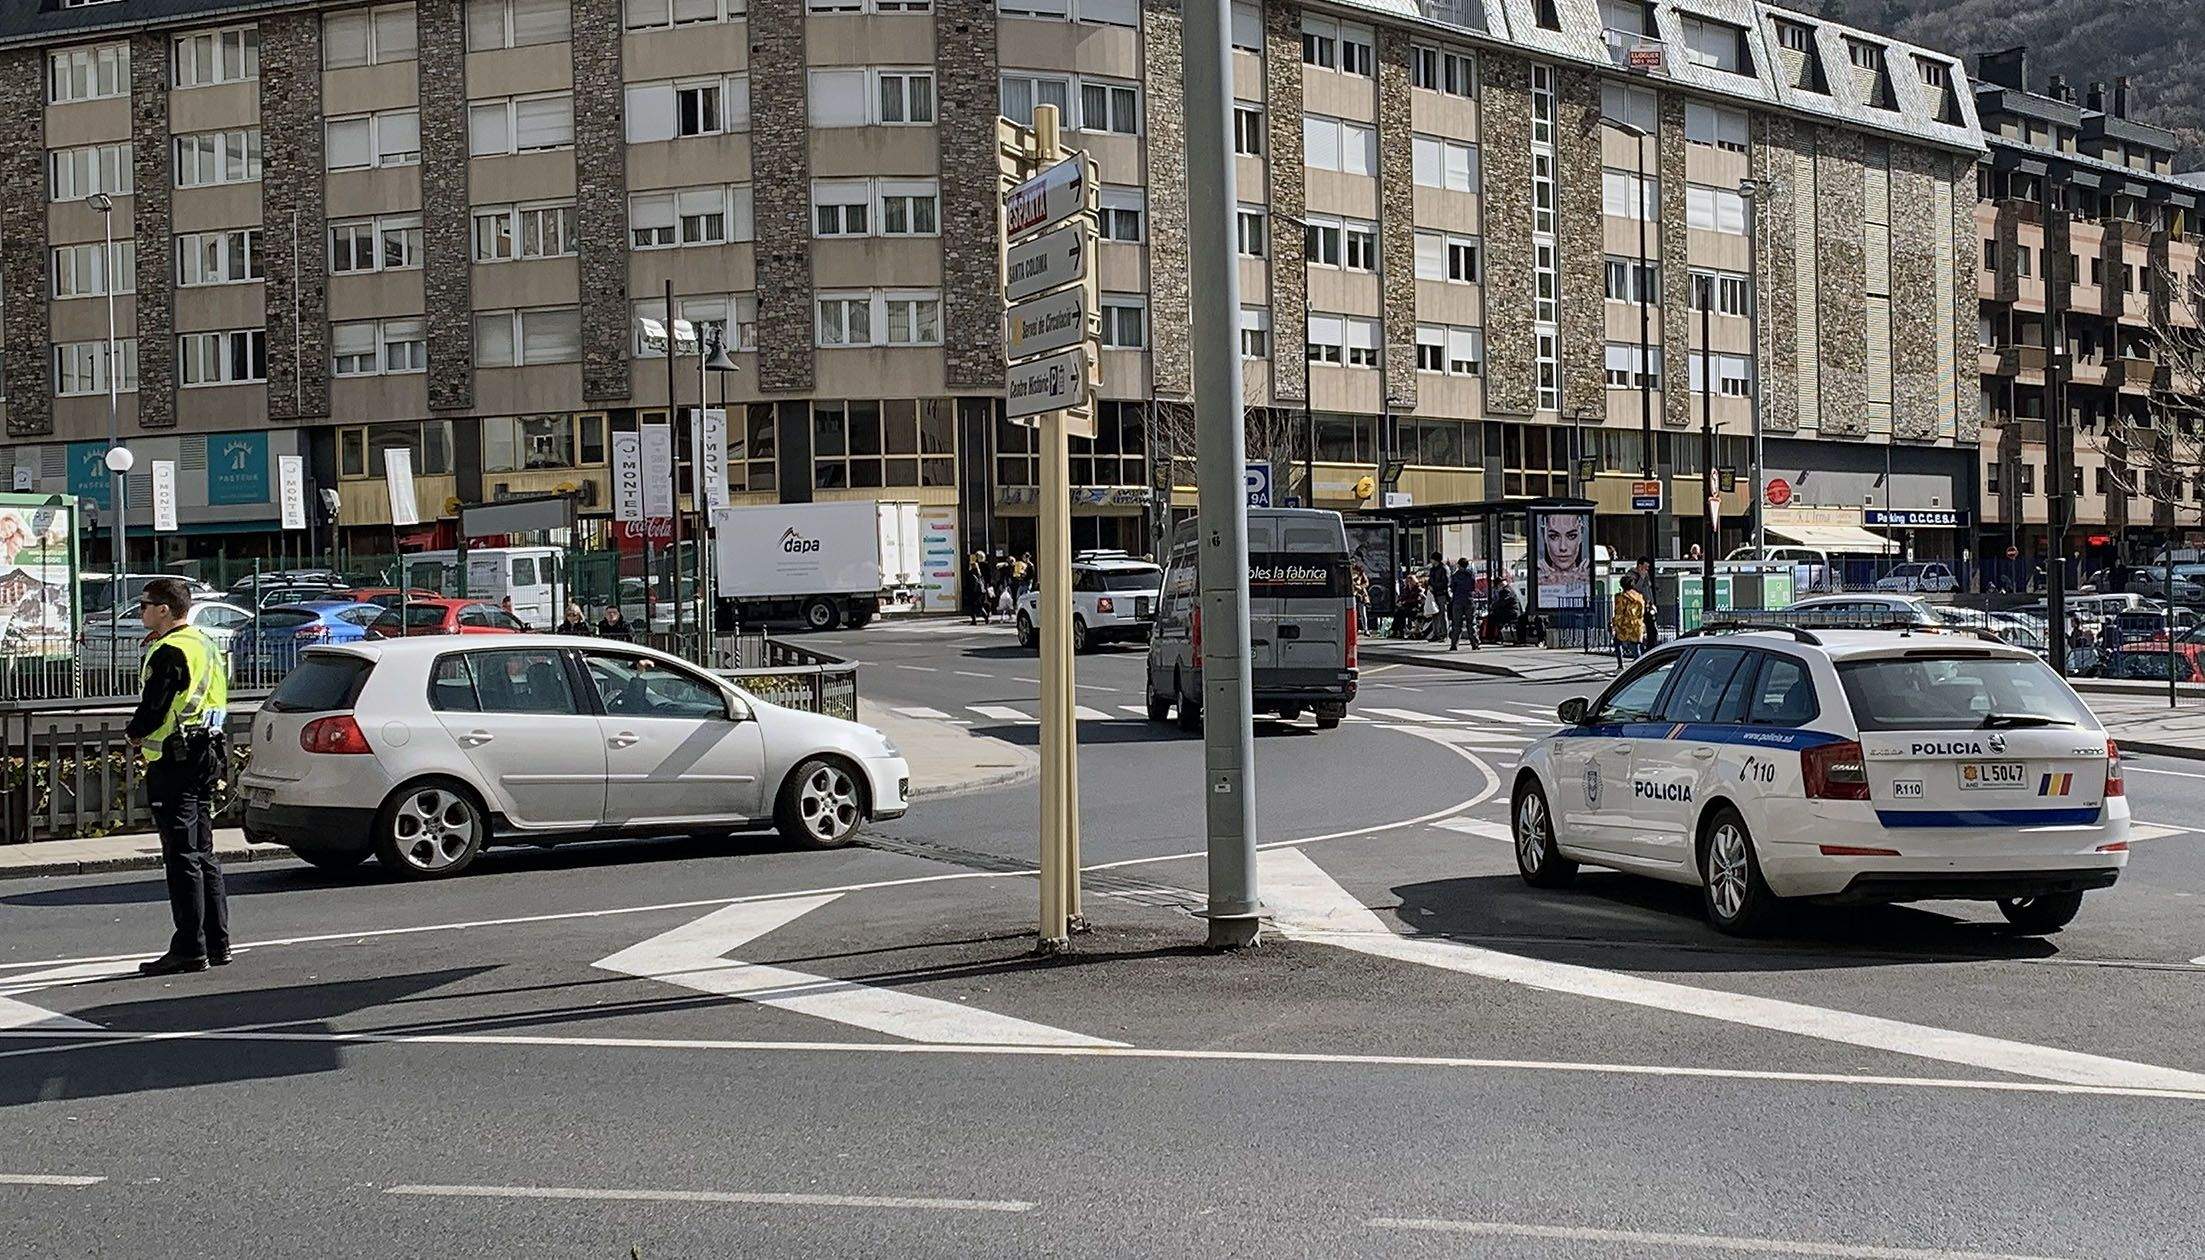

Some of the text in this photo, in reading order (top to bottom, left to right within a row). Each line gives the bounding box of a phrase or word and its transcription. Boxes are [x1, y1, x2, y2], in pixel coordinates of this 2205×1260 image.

[1877, 512, 1906, 524] Paking
[784, 538, 820, 554] dapa
[1273, 565, 1284, 579] la
[1286, 565, 1327, 579] fàbrica
[1911, 742, 1983, 756] POLICIA
[1753, 762, 1775, 783] 110
[1981, 765, 2024, 781] L 5047
[1635, 781, 1692, 803] POLICIA
